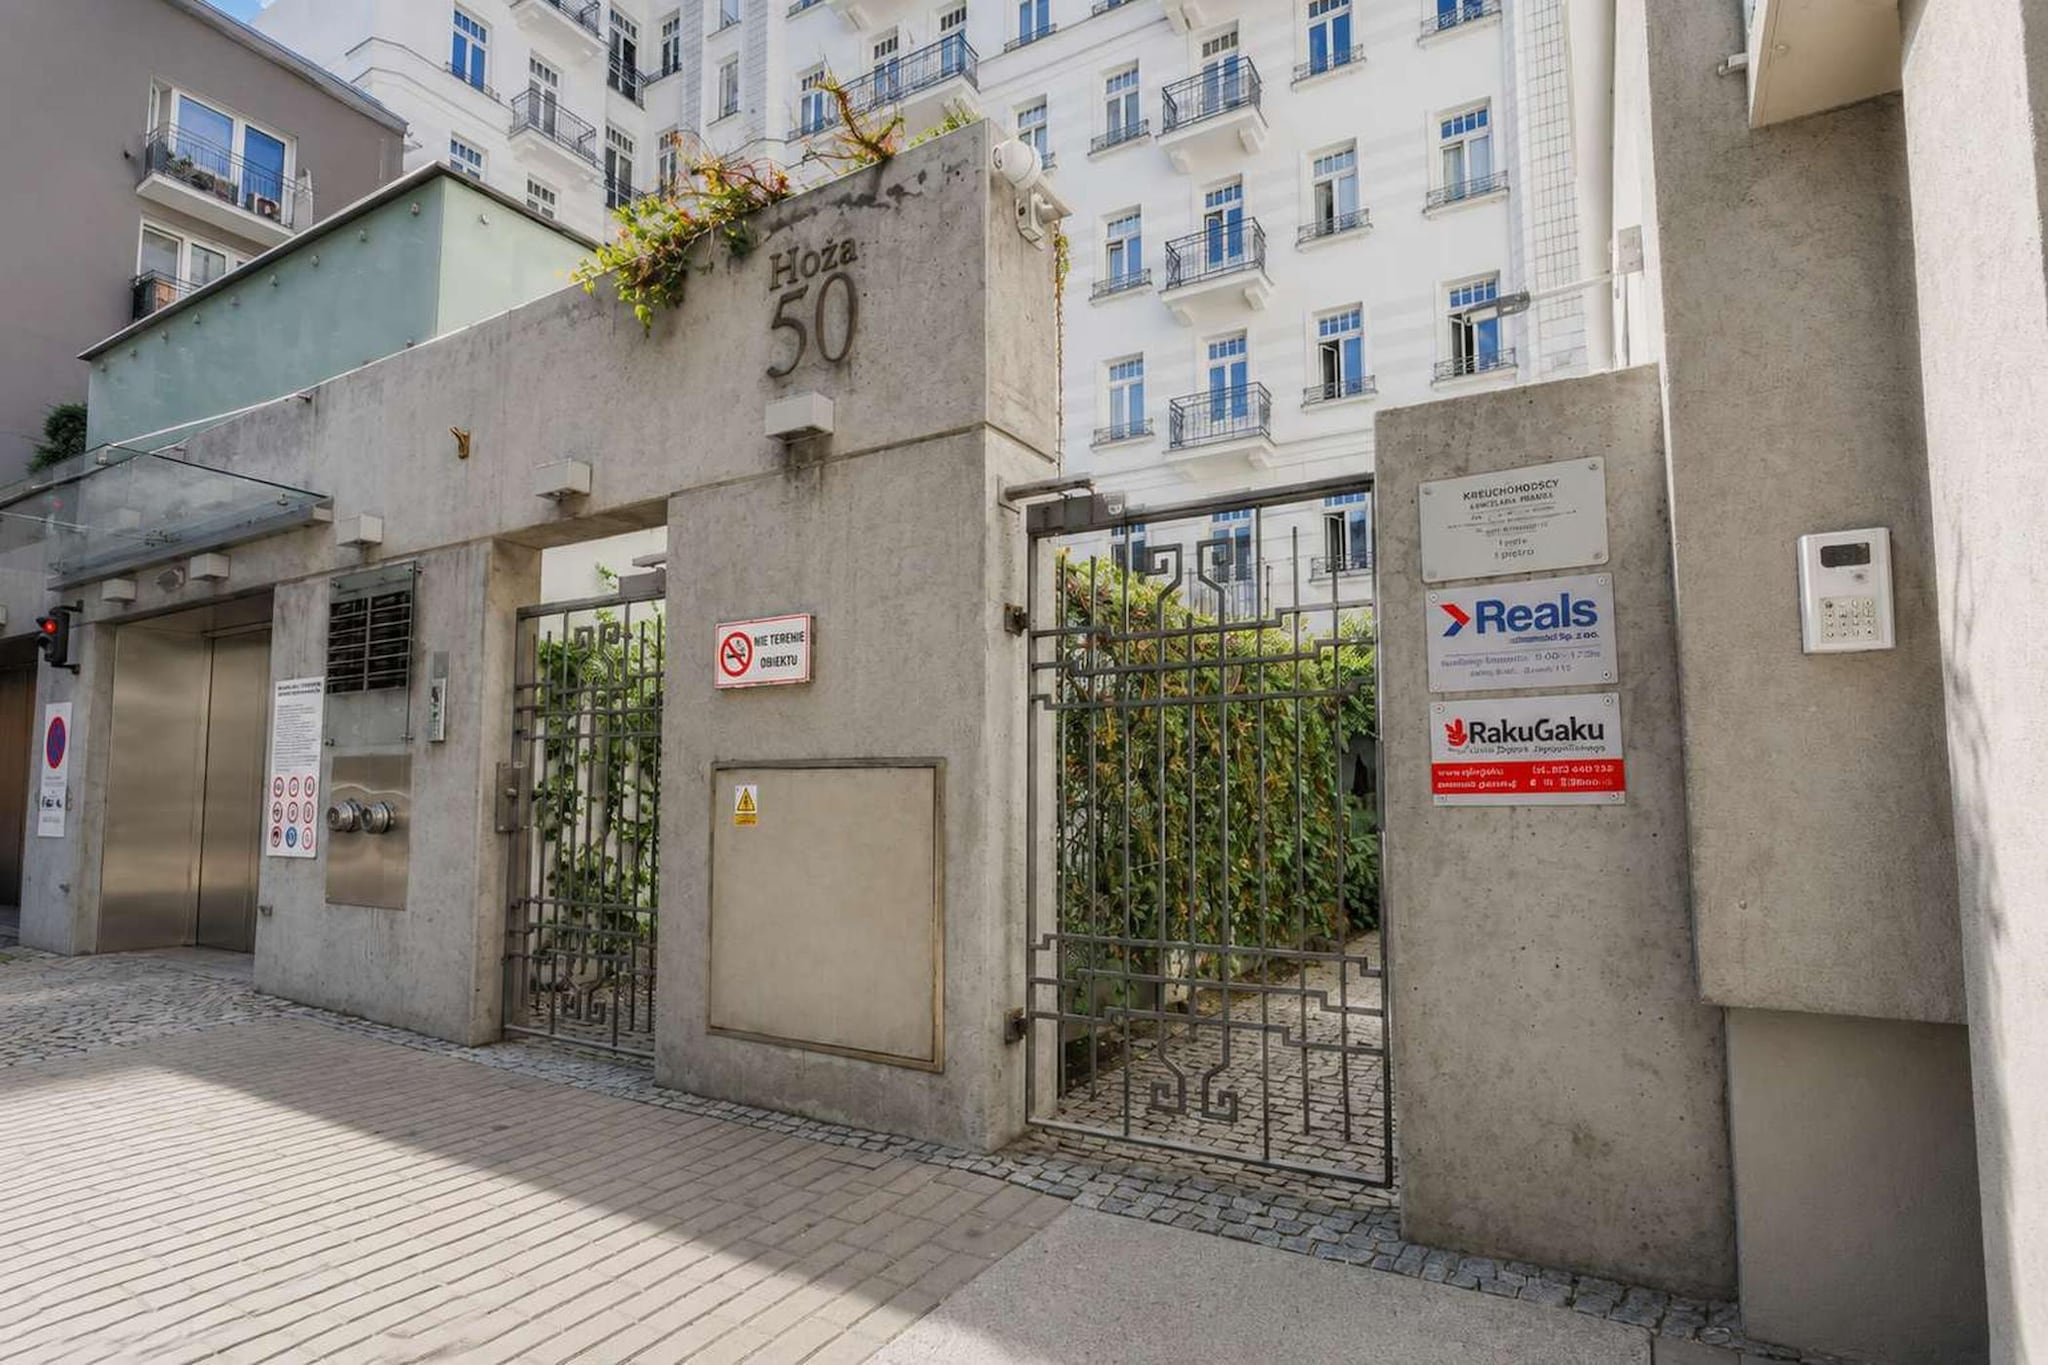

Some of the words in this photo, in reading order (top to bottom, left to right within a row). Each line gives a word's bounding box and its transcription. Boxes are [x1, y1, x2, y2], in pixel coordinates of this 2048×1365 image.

[768, 238, 859, 291] Hoża
[766, 272, 860, 378] 50
[1476, 593, 1599, 635] Reals
[1469, 716, 1605, 744] RakuGaku
